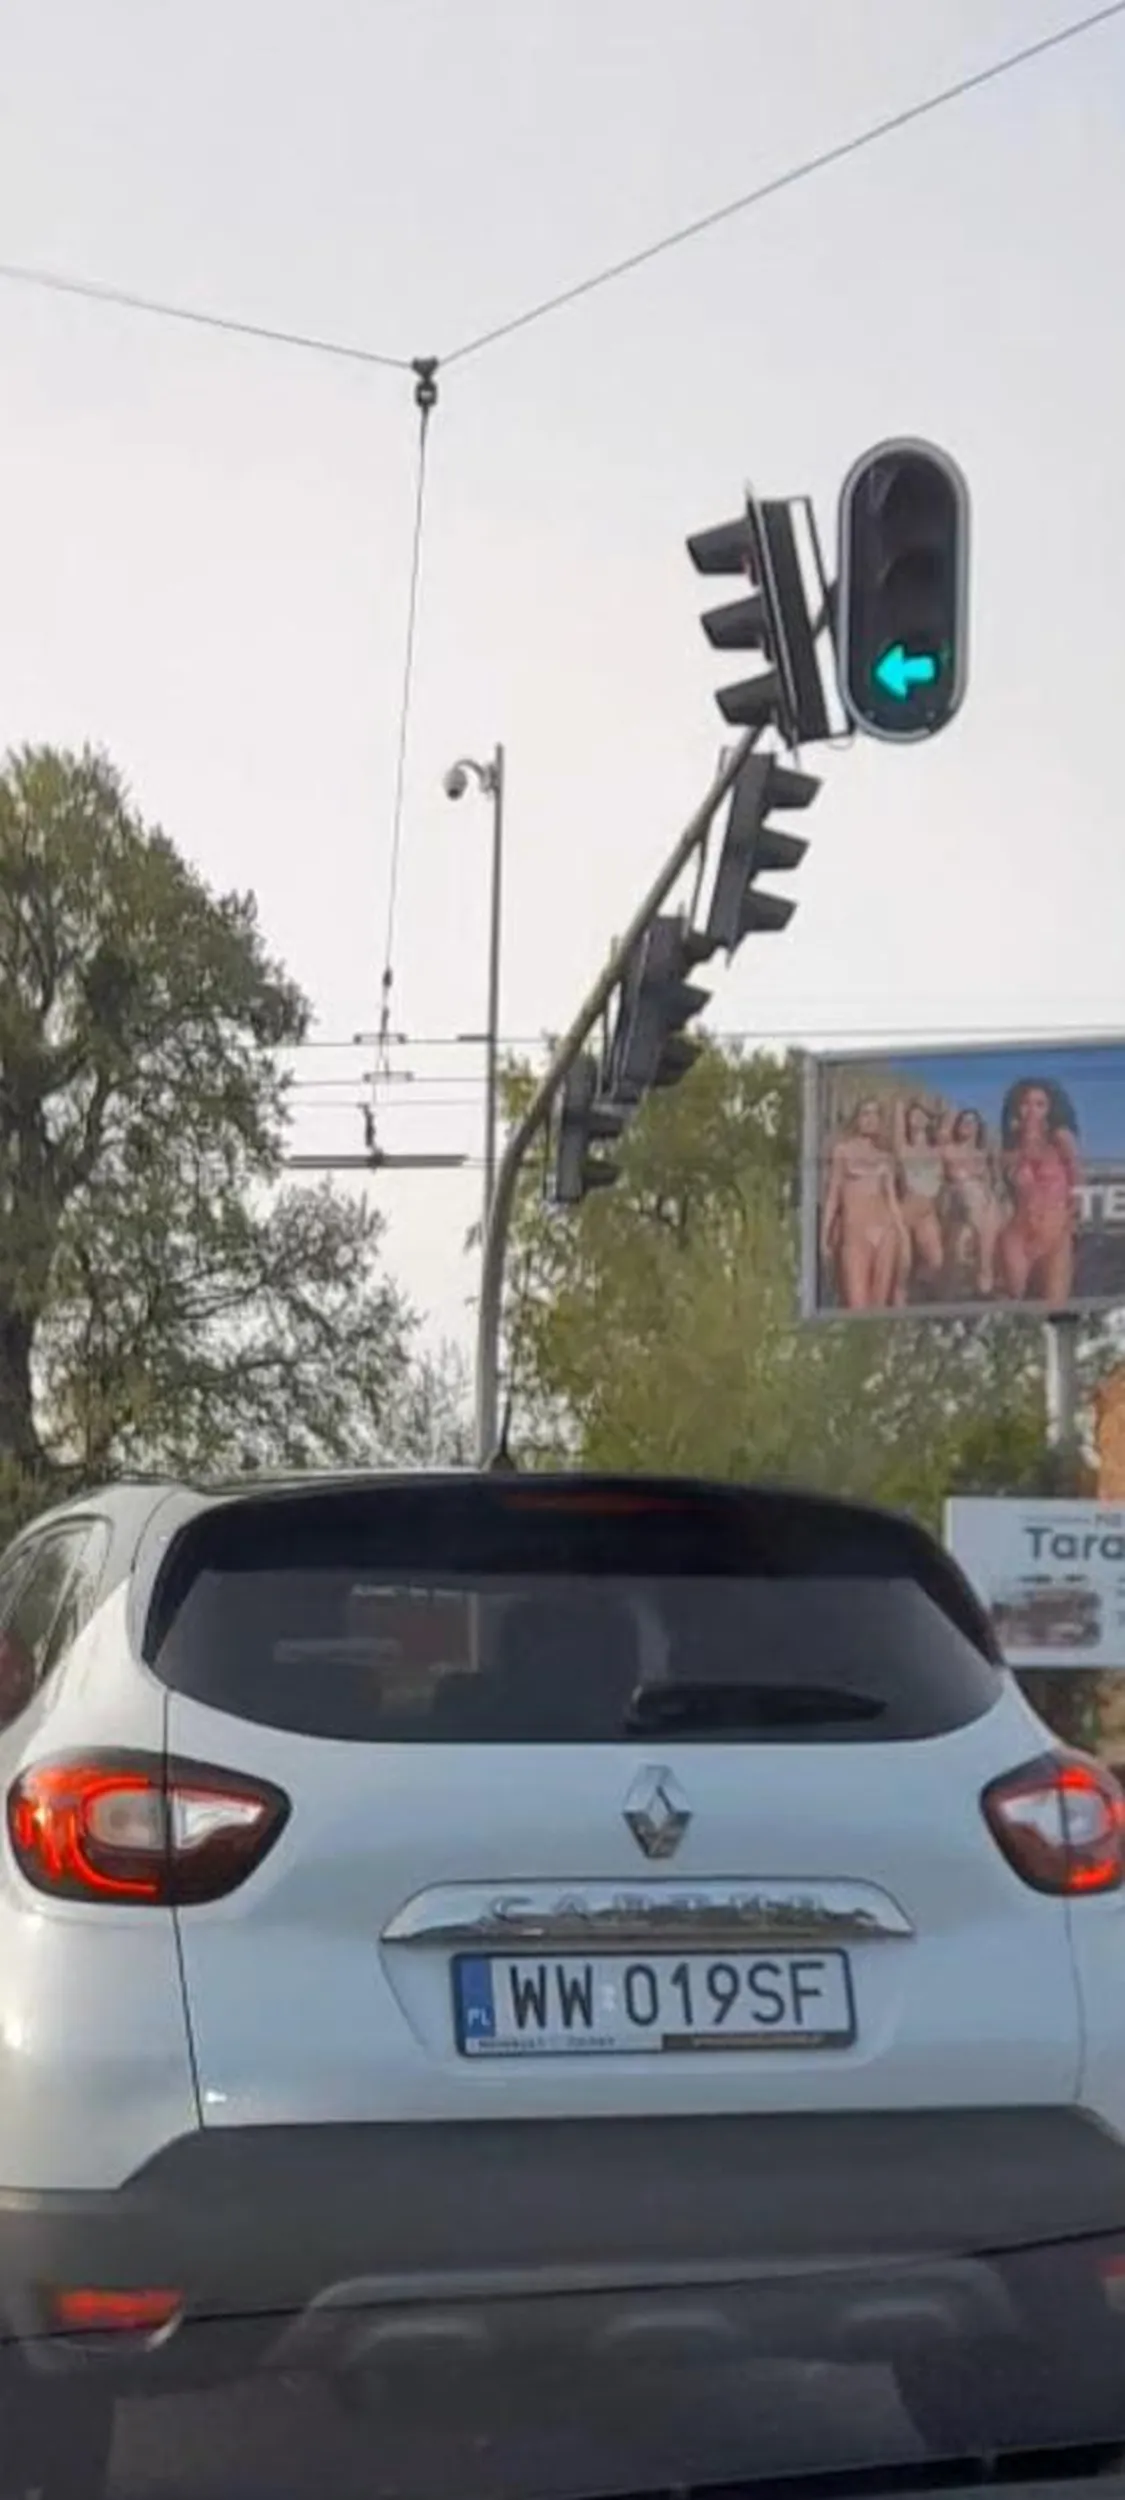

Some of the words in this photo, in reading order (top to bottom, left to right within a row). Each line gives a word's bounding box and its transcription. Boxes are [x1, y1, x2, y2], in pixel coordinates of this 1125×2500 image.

[510, 1963, 593, 2029] WW
[624, 1961, 826, 2027] 019SF
[467, 2008, 491, 2027] PL
